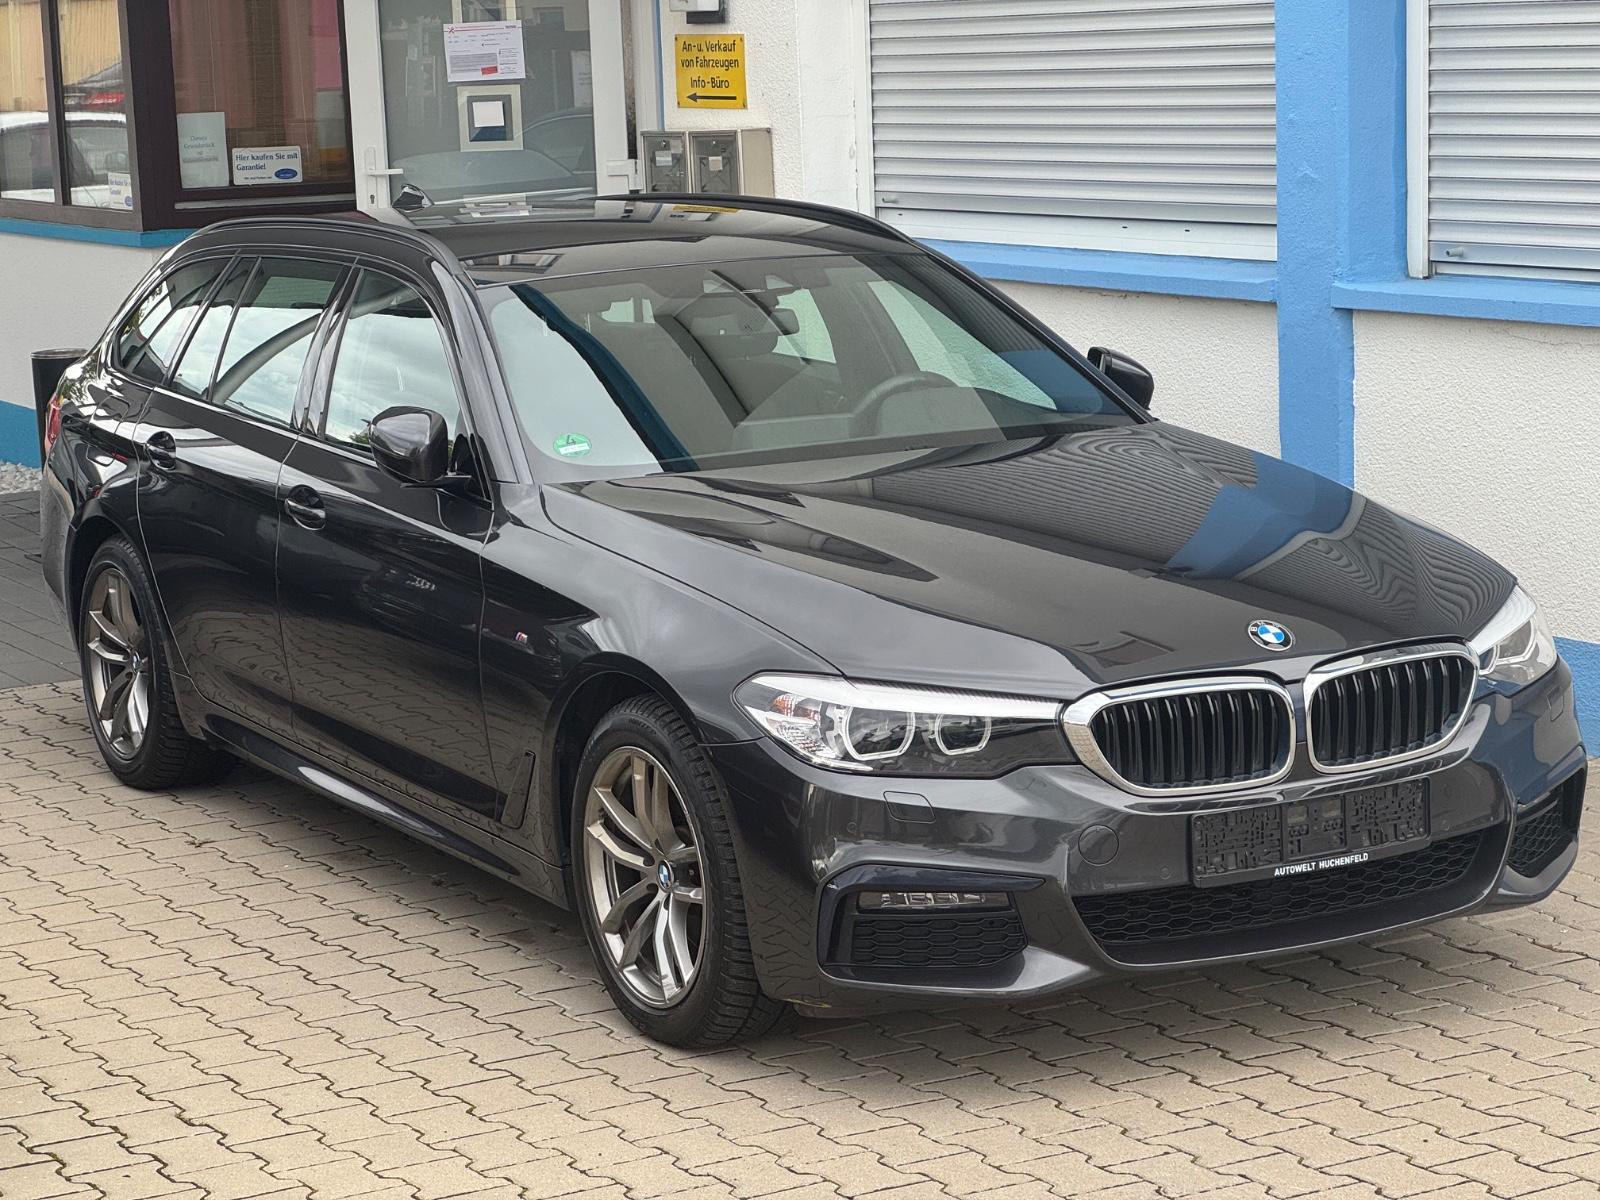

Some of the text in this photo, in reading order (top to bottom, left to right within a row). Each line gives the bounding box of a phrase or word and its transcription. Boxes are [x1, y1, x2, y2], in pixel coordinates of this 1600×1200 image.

[705, 39, 736, 52] Verkauf
[680, 56, 739, 71] von Fahrzeugen
[235, 153, 249, 161] Hier
[251, 153, 273, 161] kaufen
[275, 152, 286, 160] Sie
[236, 163, 266, 171] Garantie!
[566, 434, 576, 445] 4
[1274, 852, 1369, 877] AUTOWELT HUCHENFELD
